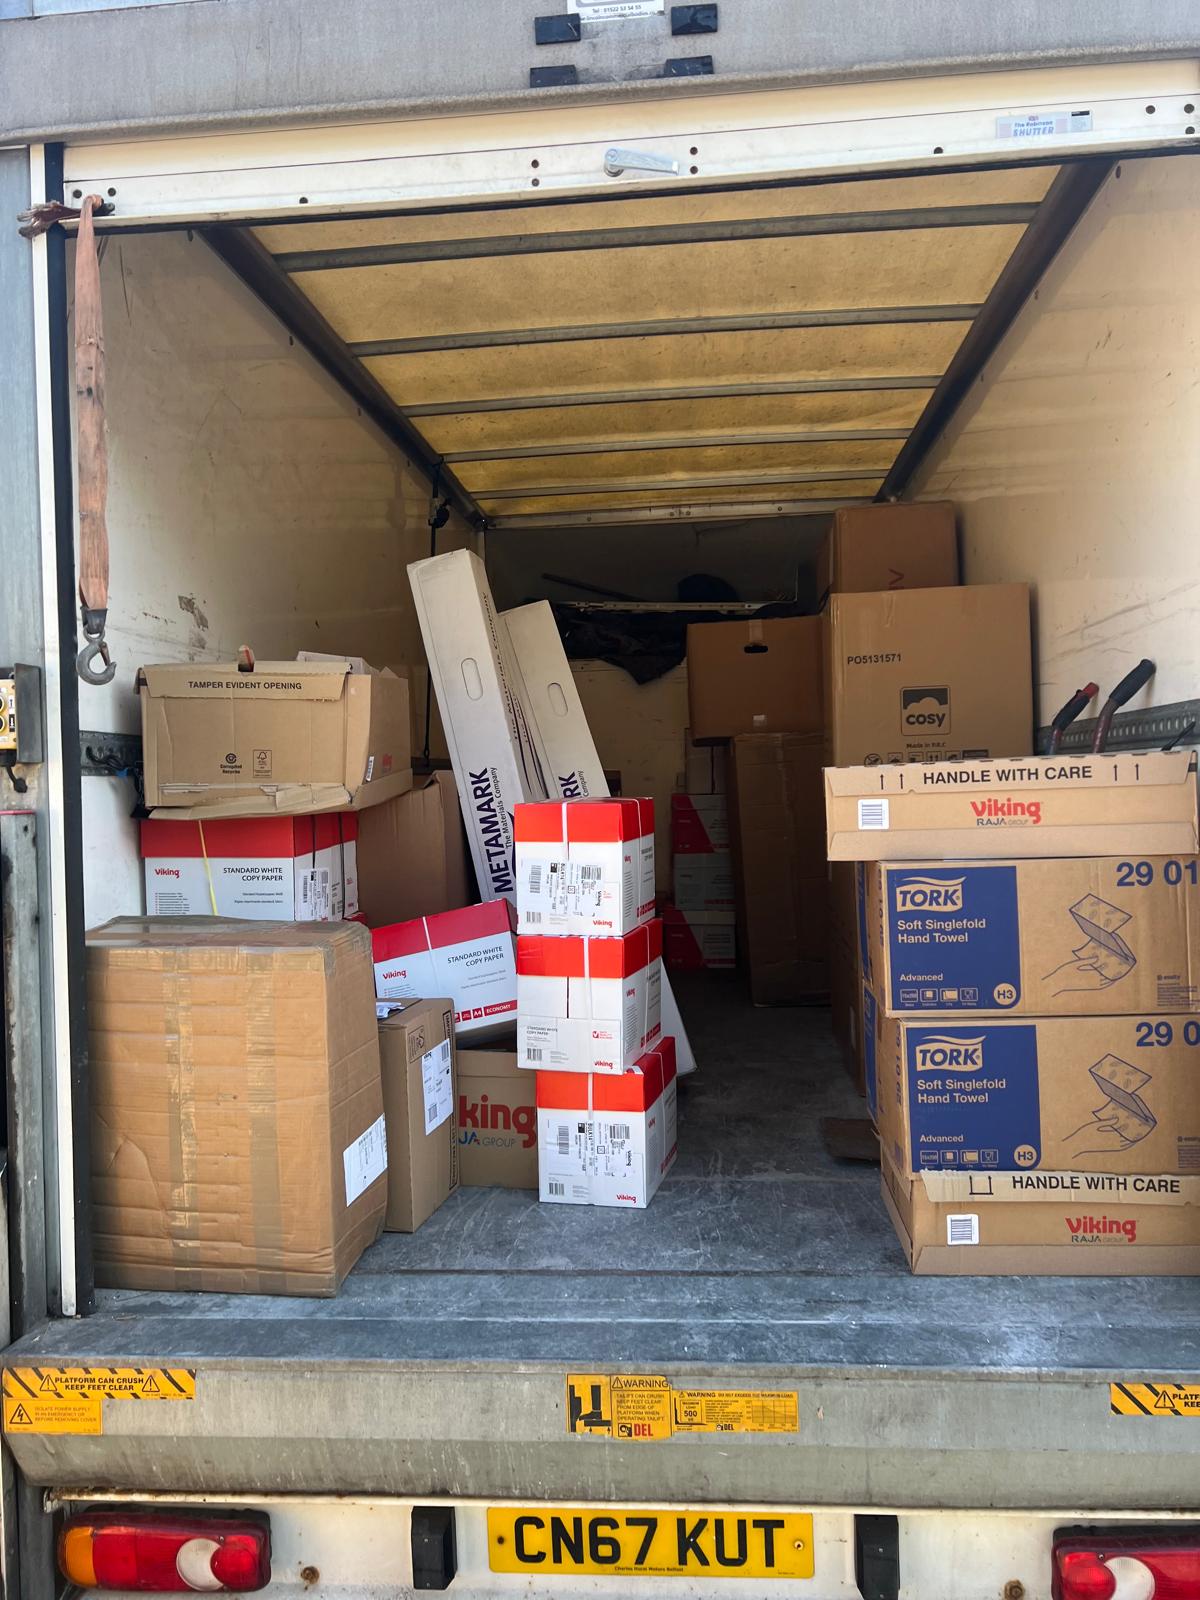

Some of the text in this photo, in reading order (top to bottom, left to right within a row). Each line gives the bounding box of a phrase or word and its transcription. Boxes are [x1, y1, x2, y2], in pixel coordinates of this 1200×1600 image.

[1013, 126, 1054, 136] SHUTTER
[188, 681, 302, 690] TAMPER EVIDENT OPENING
[906, 713, 946, 727] cosy
[923, 765, 1092, 785] HANDLE WITH CARE
[491, 767, 501, 798] Company
[578, 771, 589, 797] Company
[970, 797, 1042, 824] Viking
[497, 801, 510, 834] Materials
[976, 818, 1007, 826] RAJA
[469, 768, 513, 893] METAMARK
[155, 868, 180, 878] Viking
[1116, 860, 1197, 886] 29 01
[899, 888, 960, 906] TORK
[593, 920, 612, 928] Viking
[897, 918, 986, 930] Soft Singlefold
[898, 932, 968, 943] Hand Towel
[448, 946, 503, 964] STANDARD WHITE
[466, 953, 504, 966] COPY PAPER
[383, 969, 407, 980] Viking
[900, 973, 944, 981] Advanced
[997, 990, 1013, 999] H3
[486, 1004, 511, 1013] ECONOMY
[1136, 1022, 1173, 1046] 29
[918, 1049, 979, 1066] TORK
[594, 1060, 613, 1069] Viking
[917, 1079, 1006, 1090] Soft Singlefold
[918, 1093, 989, 1104] Hand Towel
[459, 1094, 537, 1149] king
[459, 1131, 516, 1148] JA GROUP
[920, 1134, 963, 1143] Advanced
[1017, 1152, 1033, 1161] H3
[1012, 1176, 1180, 1193] HANDLE WITH CARE
[617, 1194, 636, 1203] Viking
[1064, 1216, 1136, 1242] Viking
[634, 1424, 653, 1436] DEL
[514, 1516, 784, 1567] CN67 KUT
